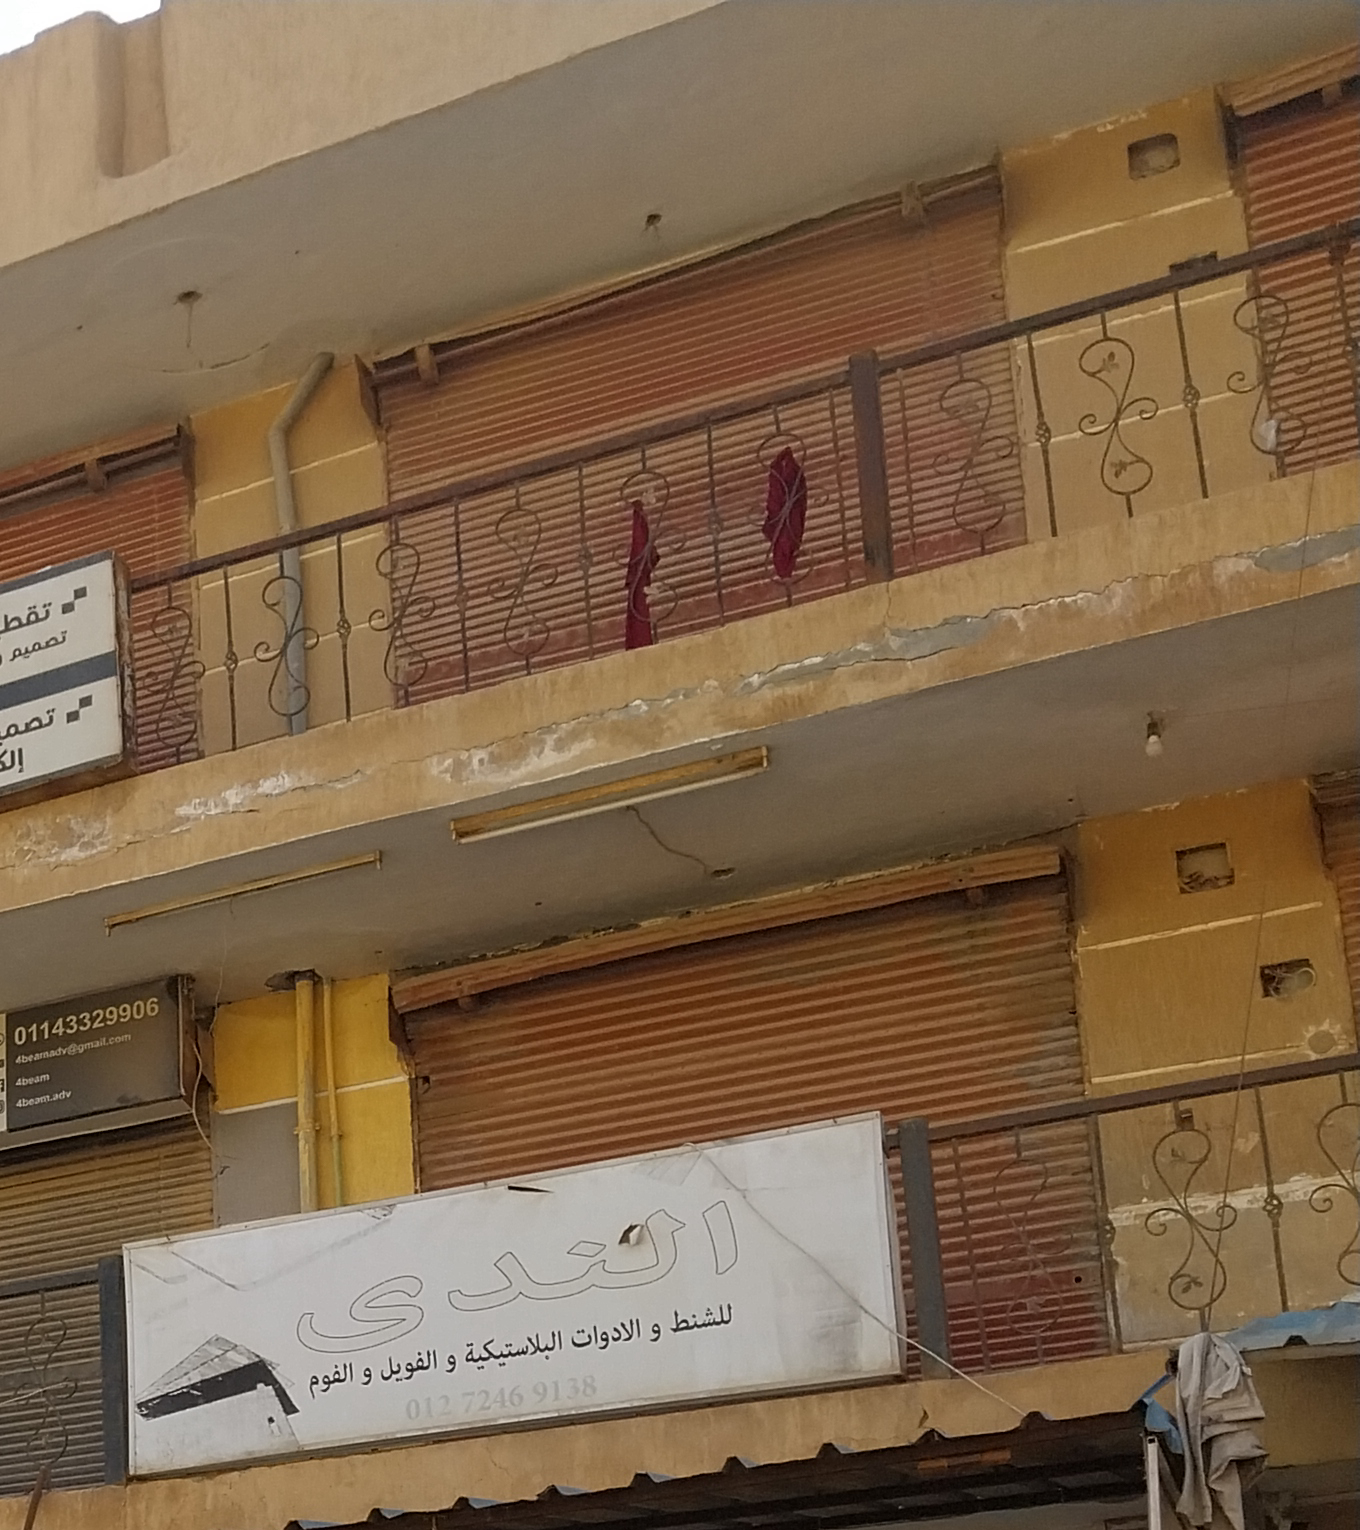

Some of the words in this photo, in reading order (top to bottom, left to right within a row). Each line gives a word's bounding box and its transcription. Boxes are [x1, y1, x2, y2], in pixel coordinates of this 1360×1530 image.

[10, 630, 68, 661] تصميم
[14, 997, 159, 1045] 01143329906
[15, 1033, 132, 1064] 4beamadv@gmail.com
[15, 1073, 50, 1087] 4beam
[15, 1089, 72, 1108] 4beam.adv
[570, 1318, 642, 1351] الادوات
[650, 1322, 662, 1342] و
[670, 1303, 733, 1335] للشنط
[380, 1349, 438, 1383] الفويل
[445, 1353, 457, 1373] و
[464, 1330, 563, 1372] البلاستيكية
[309, 1362, 354, 1399] الفوم
[362, 1365, 373, 1385] و
[406, 1392, 452, 1421] 012
[461, 1384, 525, 1416] 7246
[532, 1374, 598, 1405] 9138
